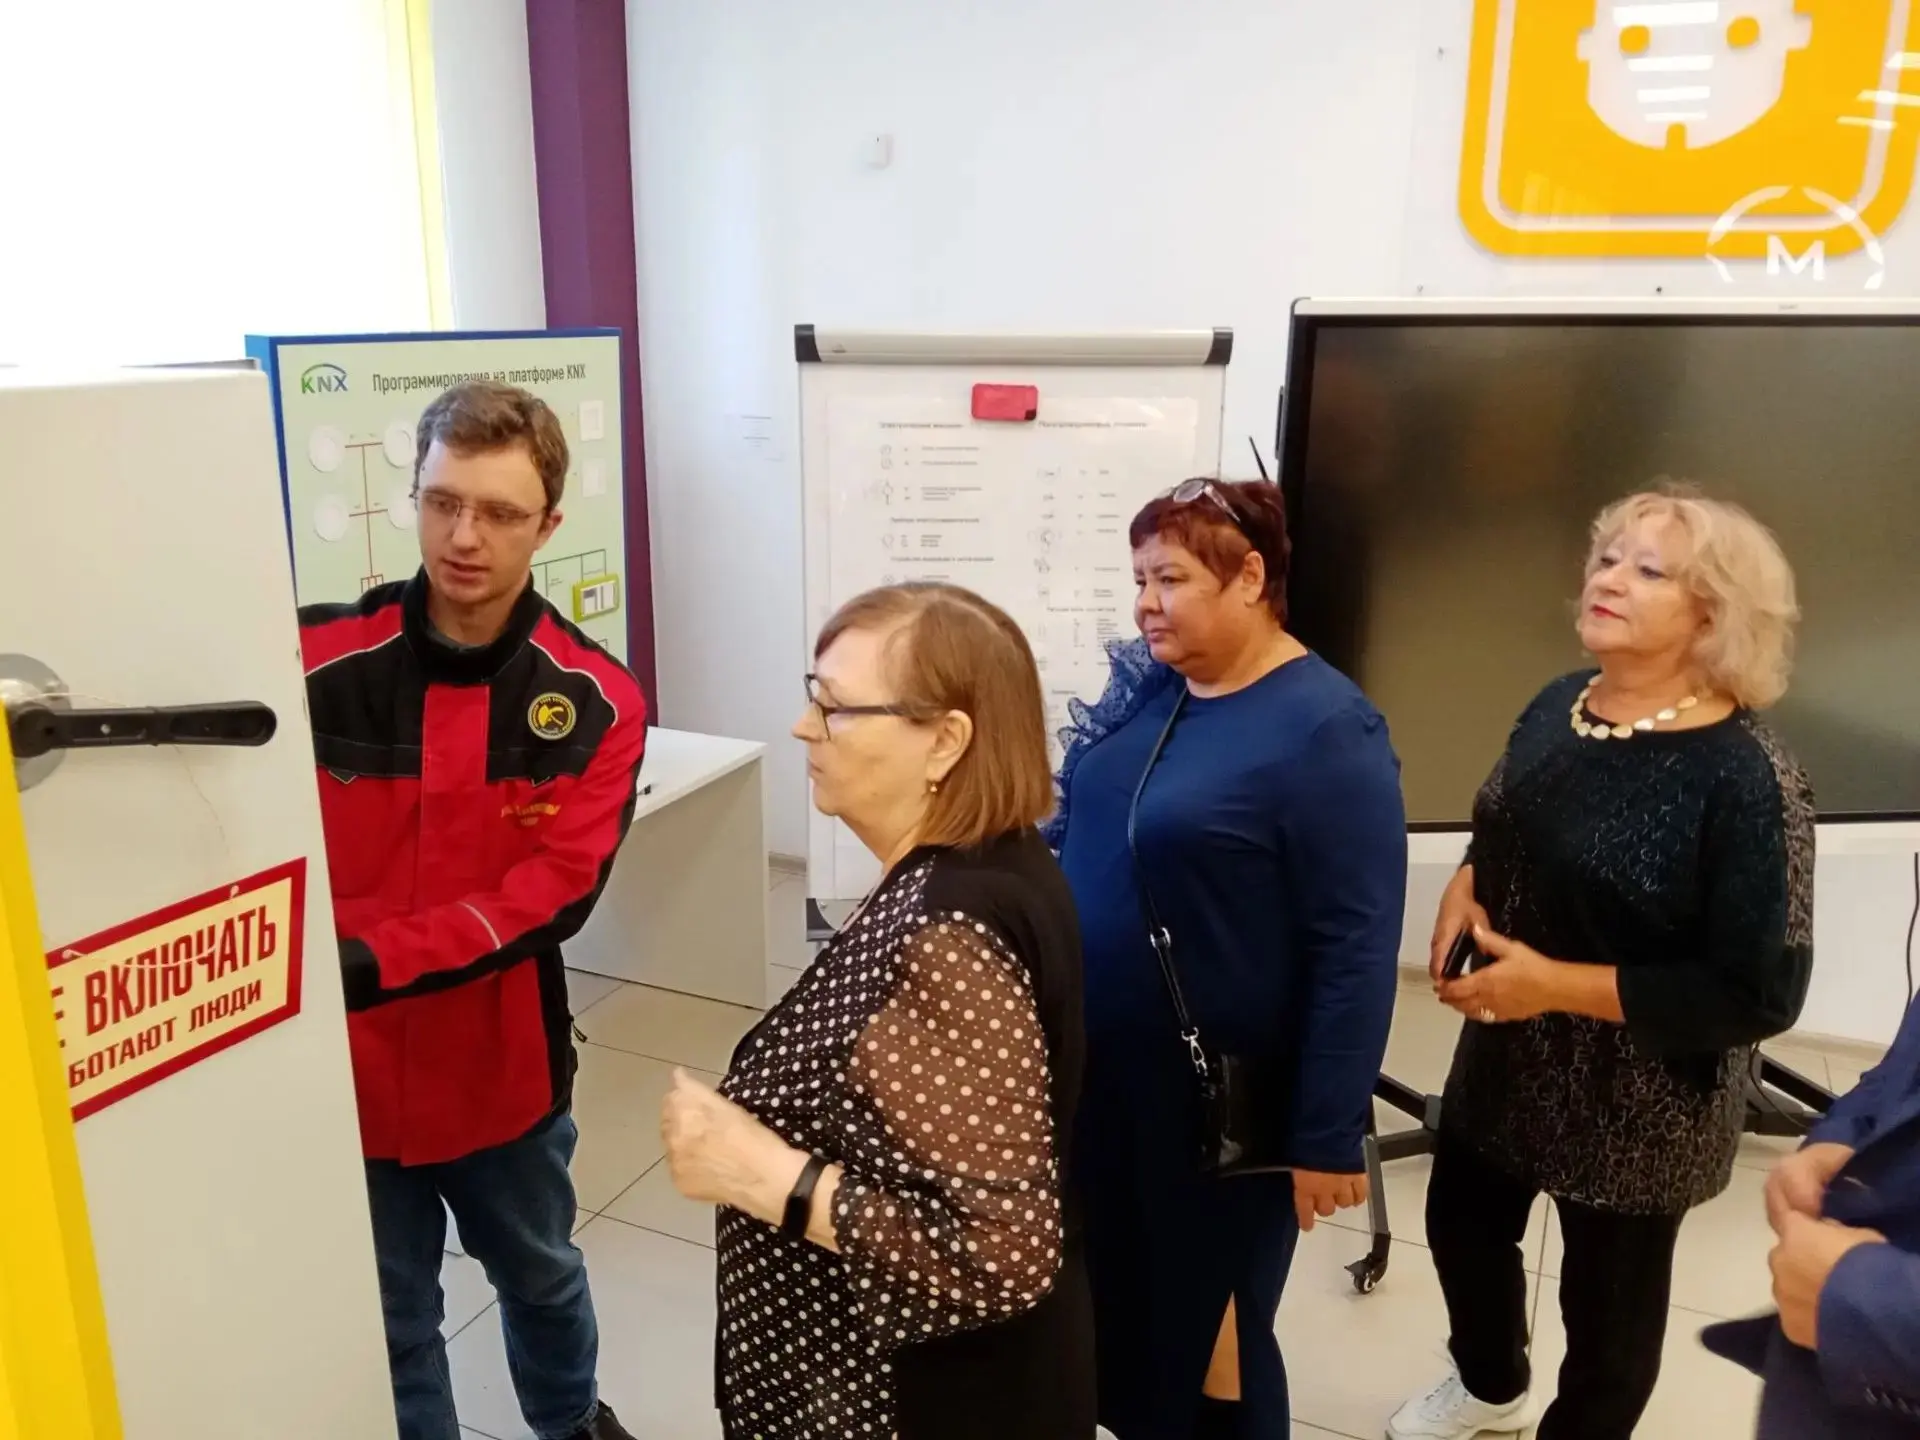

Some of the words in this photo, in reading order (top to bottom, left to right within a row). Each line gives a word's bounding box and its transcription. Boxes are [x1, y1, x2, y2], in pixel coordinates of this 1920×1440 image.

[301, 374, 348, 394] KNX
[493, 370, 506, 382] на
[508, 365, 565, 385] платформе
[566, 363, 586, 380] KNX
[85, 905, 276, 1036] ВКЛЮЧАТЬ
[189, 979, 262, 1032] ЛЮДИ
